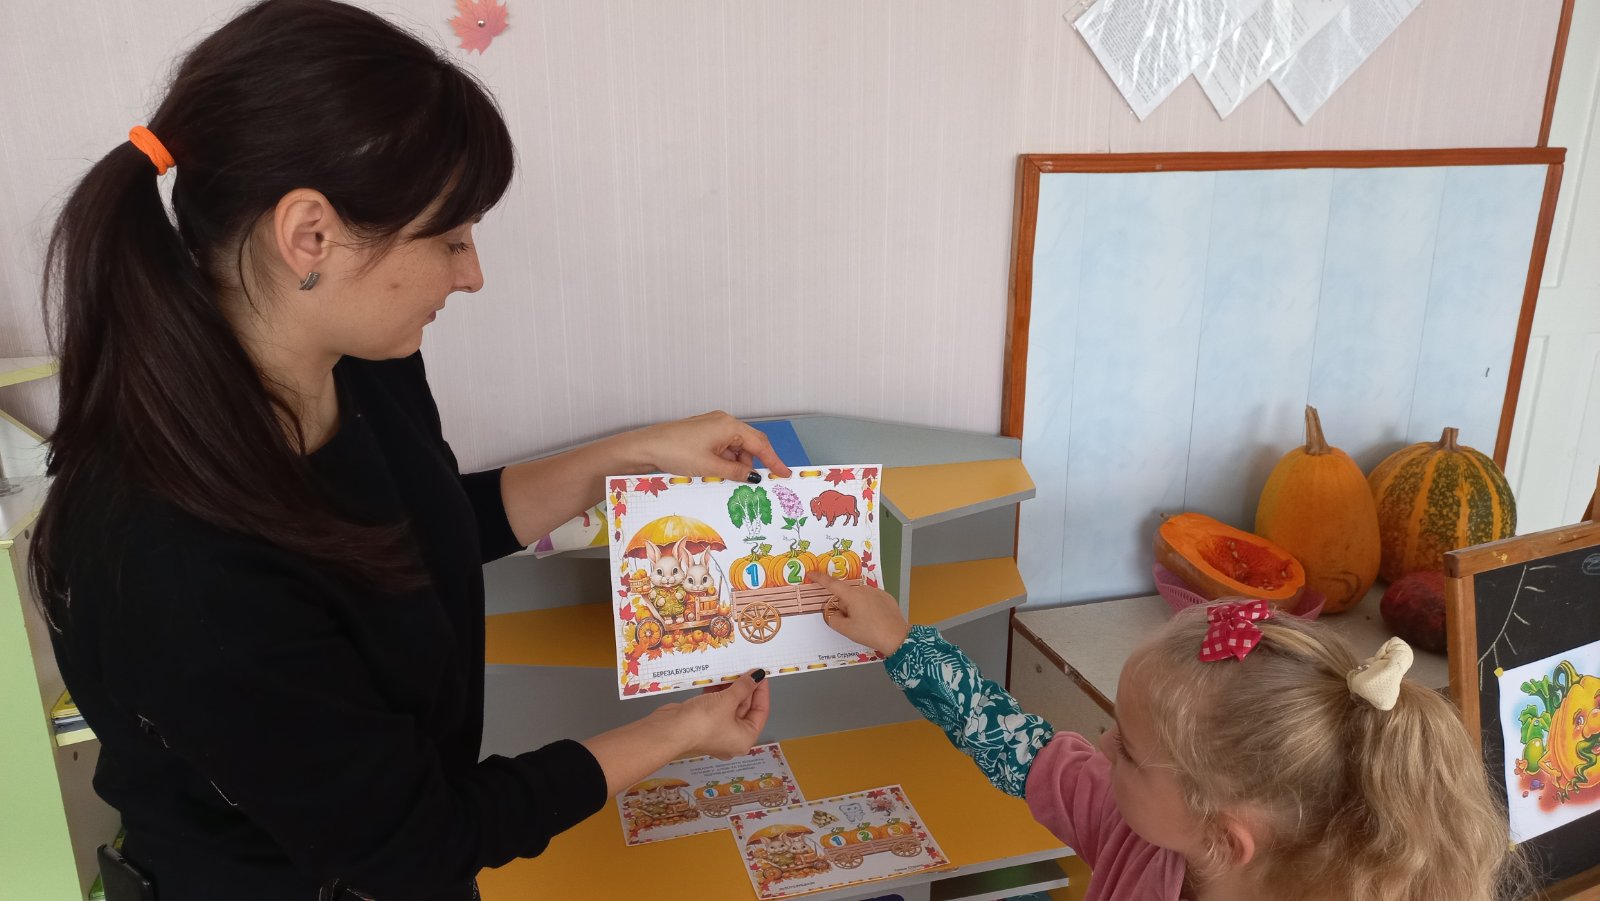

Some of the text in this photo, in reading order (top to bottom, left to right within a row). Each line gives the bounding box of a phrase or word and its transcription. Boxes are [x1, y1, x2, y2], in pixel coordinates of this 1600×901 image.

[746, 557, 848, 587] 1 2 3
[831, 835, 842, 846] 1
[858, 830, 872, 841] 2
